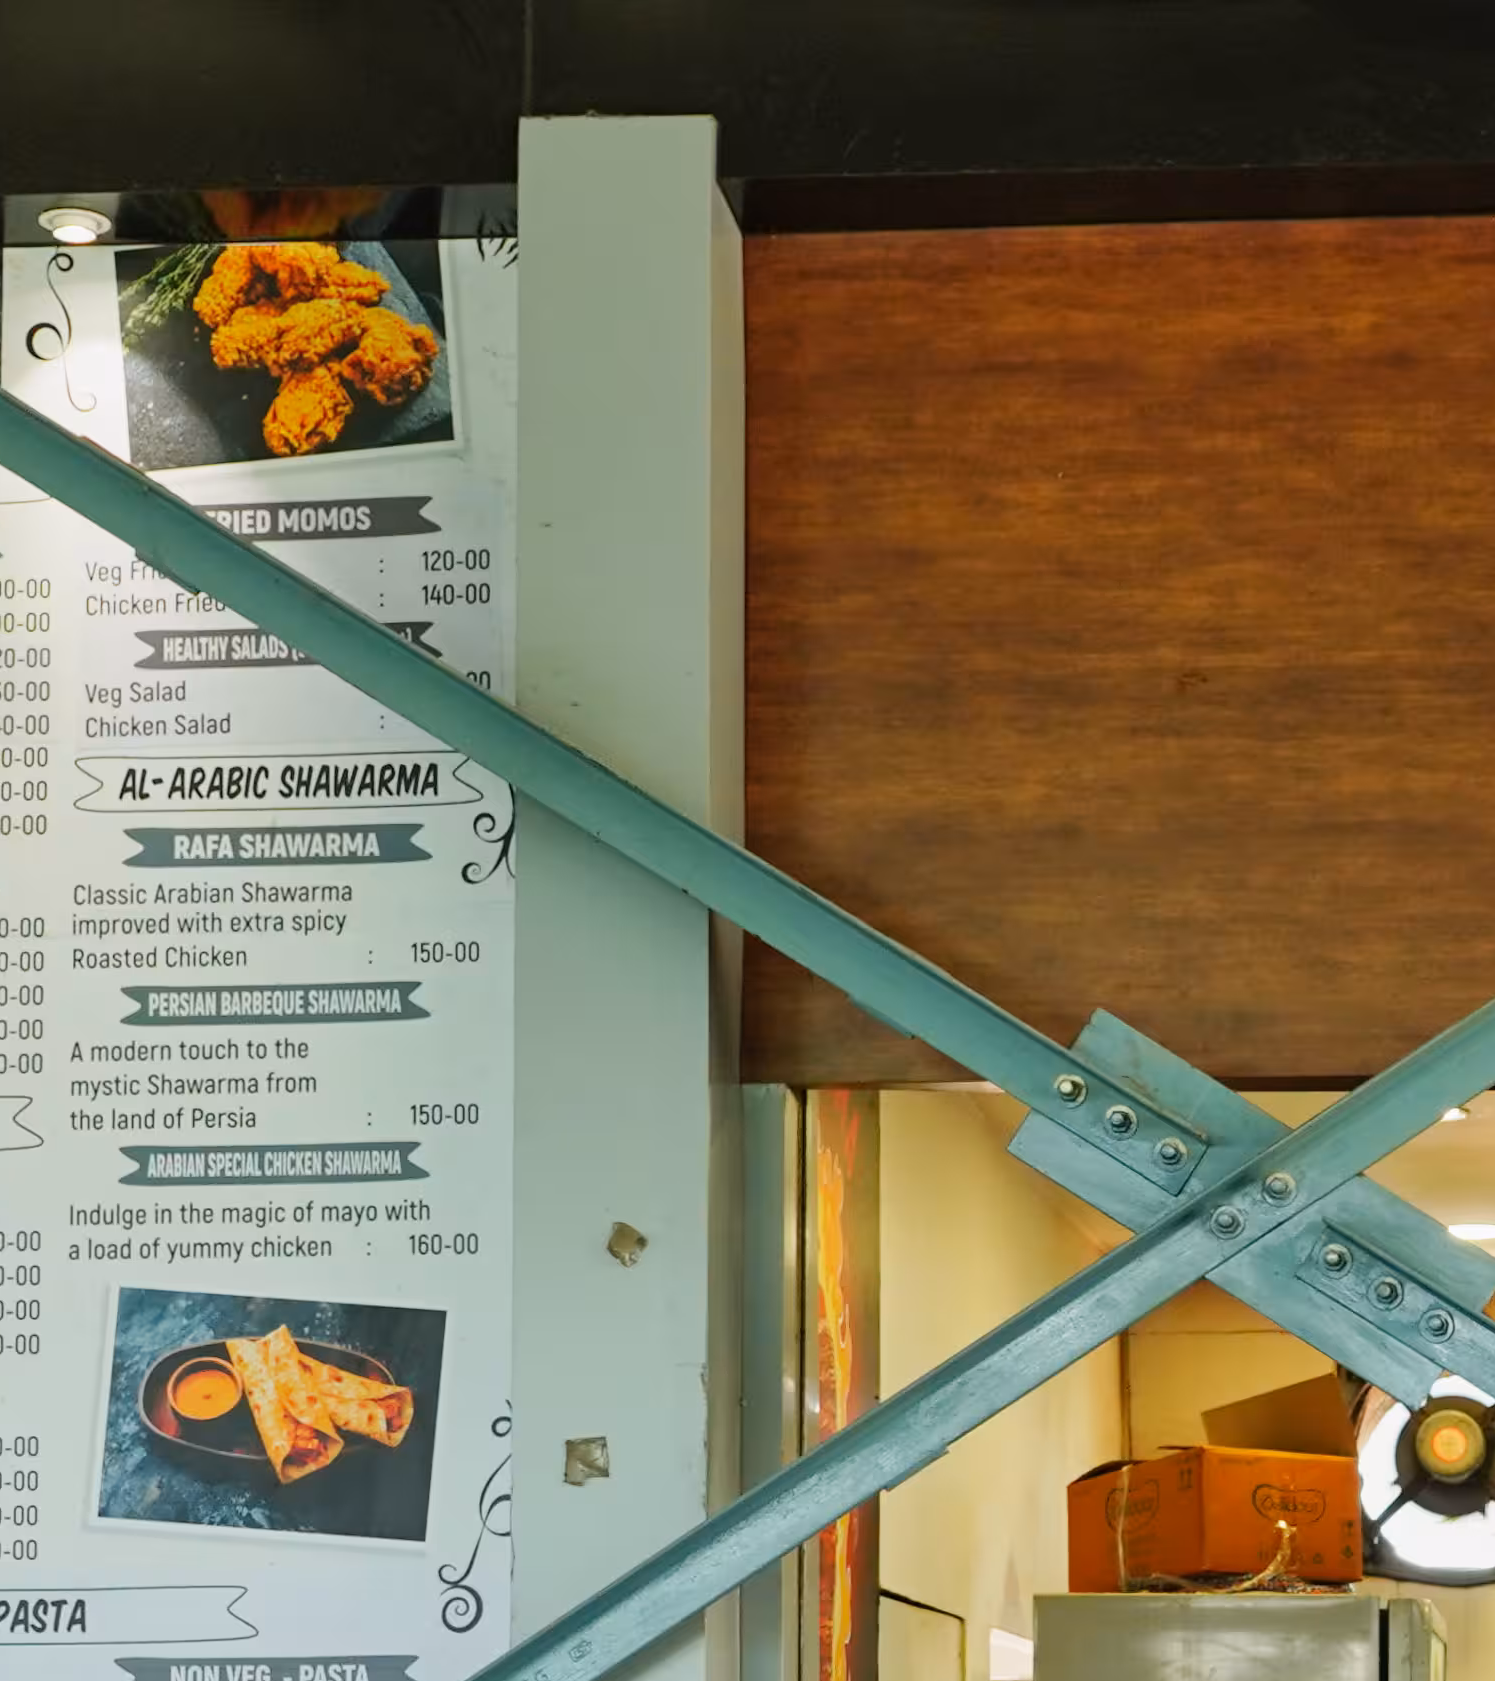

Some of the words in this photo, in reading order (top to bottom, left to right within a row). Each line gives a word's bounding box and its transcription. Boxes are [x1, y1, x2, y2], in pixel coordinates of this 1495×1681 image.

[278, 505, 372, 533] MOMOS
[422, 548, 491, 572] 120-00
[84, 683, 122, 709] Veg
[129, 680, 186, 703] Salad
[118, 765, 270, 801] AL-ARABIC
[278, 762, 439, 799] SHAWARMA
[173, 834, 234, 860] RAFA
[238, 832, 380, 859] SHAWARMA
[73, 884, 147, 906] Classic
[153, 882, 234, 904] Arabian
[241, 881, 353, 903] Shawarma
[72, 912, 170, 940] improved
[177, 911, 223, 934] with
[230, 912, 284, 933] extra
[291, 908, 347, 937] spicy
[148, 991, 217, 1017] PERSIAN
[220, 990, 305, 1017] BARBEQUE
[307, 988, 402, 1015] SHAWARMA
